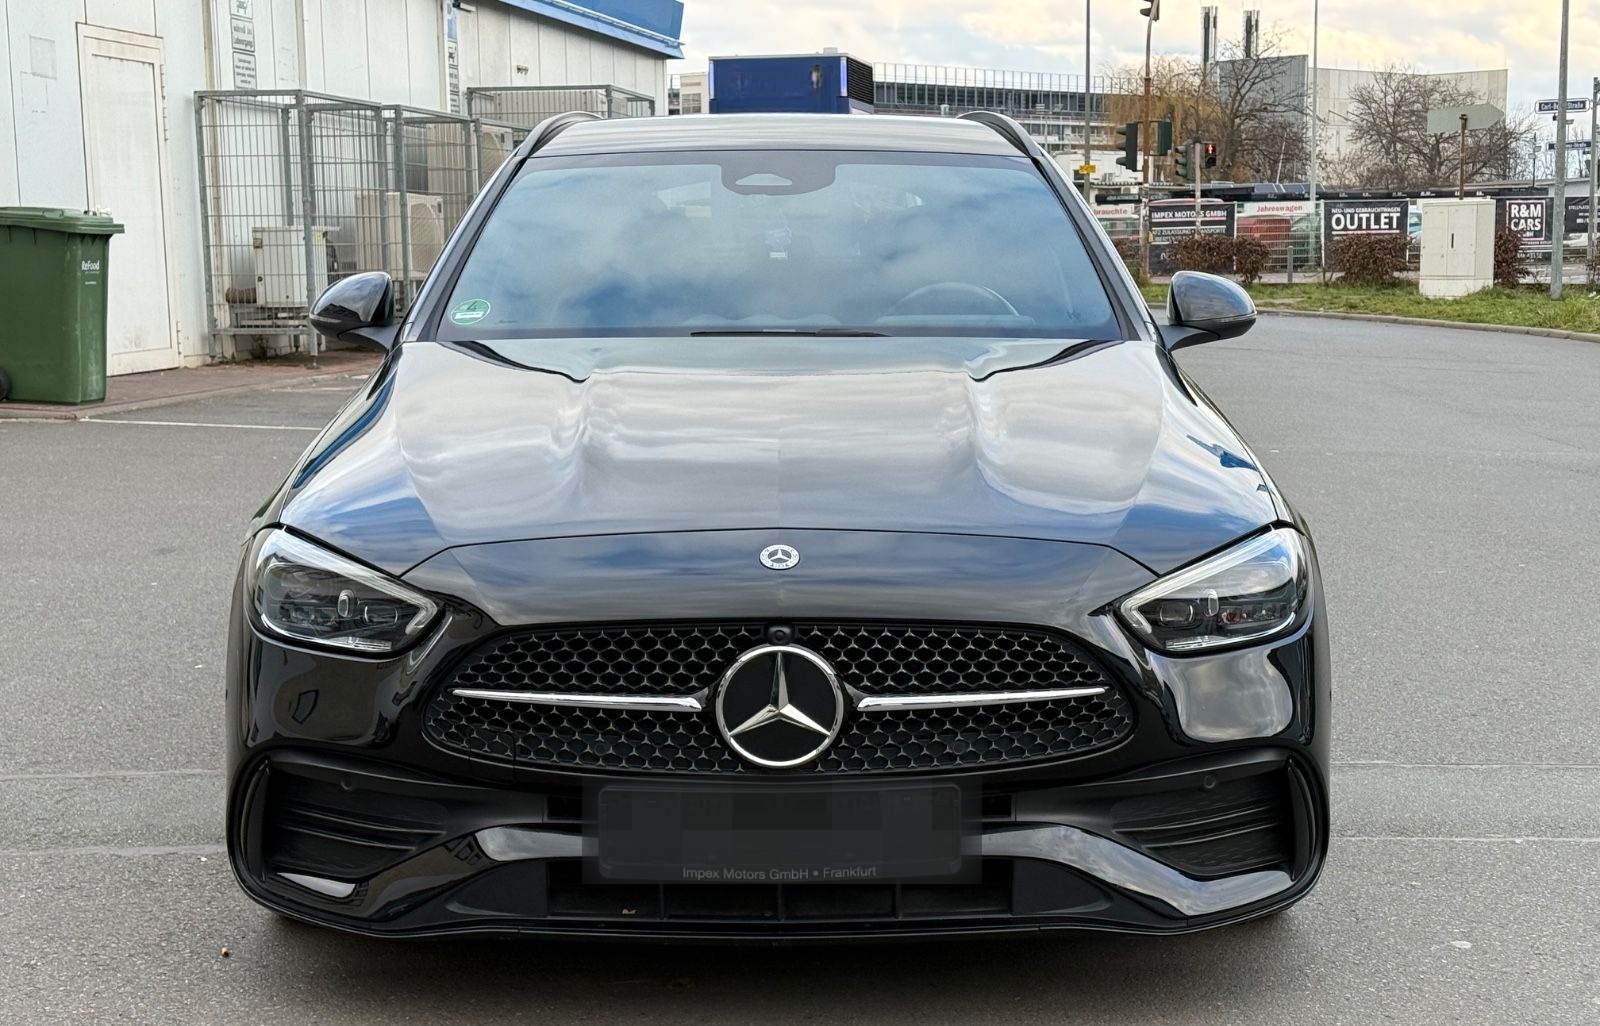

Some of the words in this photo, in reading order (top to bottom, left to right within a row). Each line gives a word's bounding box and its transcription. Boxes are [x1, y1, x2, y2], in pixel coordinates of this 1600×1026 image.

[1174, 210, 1204, 218] MOTOS
[1510, 204, 1542, 218] R&M
[1331, 213, 1401, 230] OUTLET
[1510, 218, 1542, 231] CARS
[81, 260, 100, 270] ReFood
[683, 867, 720, 880] Impex
[723, 868, 766, 880] Motors
[769, 868, 809, 880] GmbH
[823, 866, 877, 878] Frankfurt
